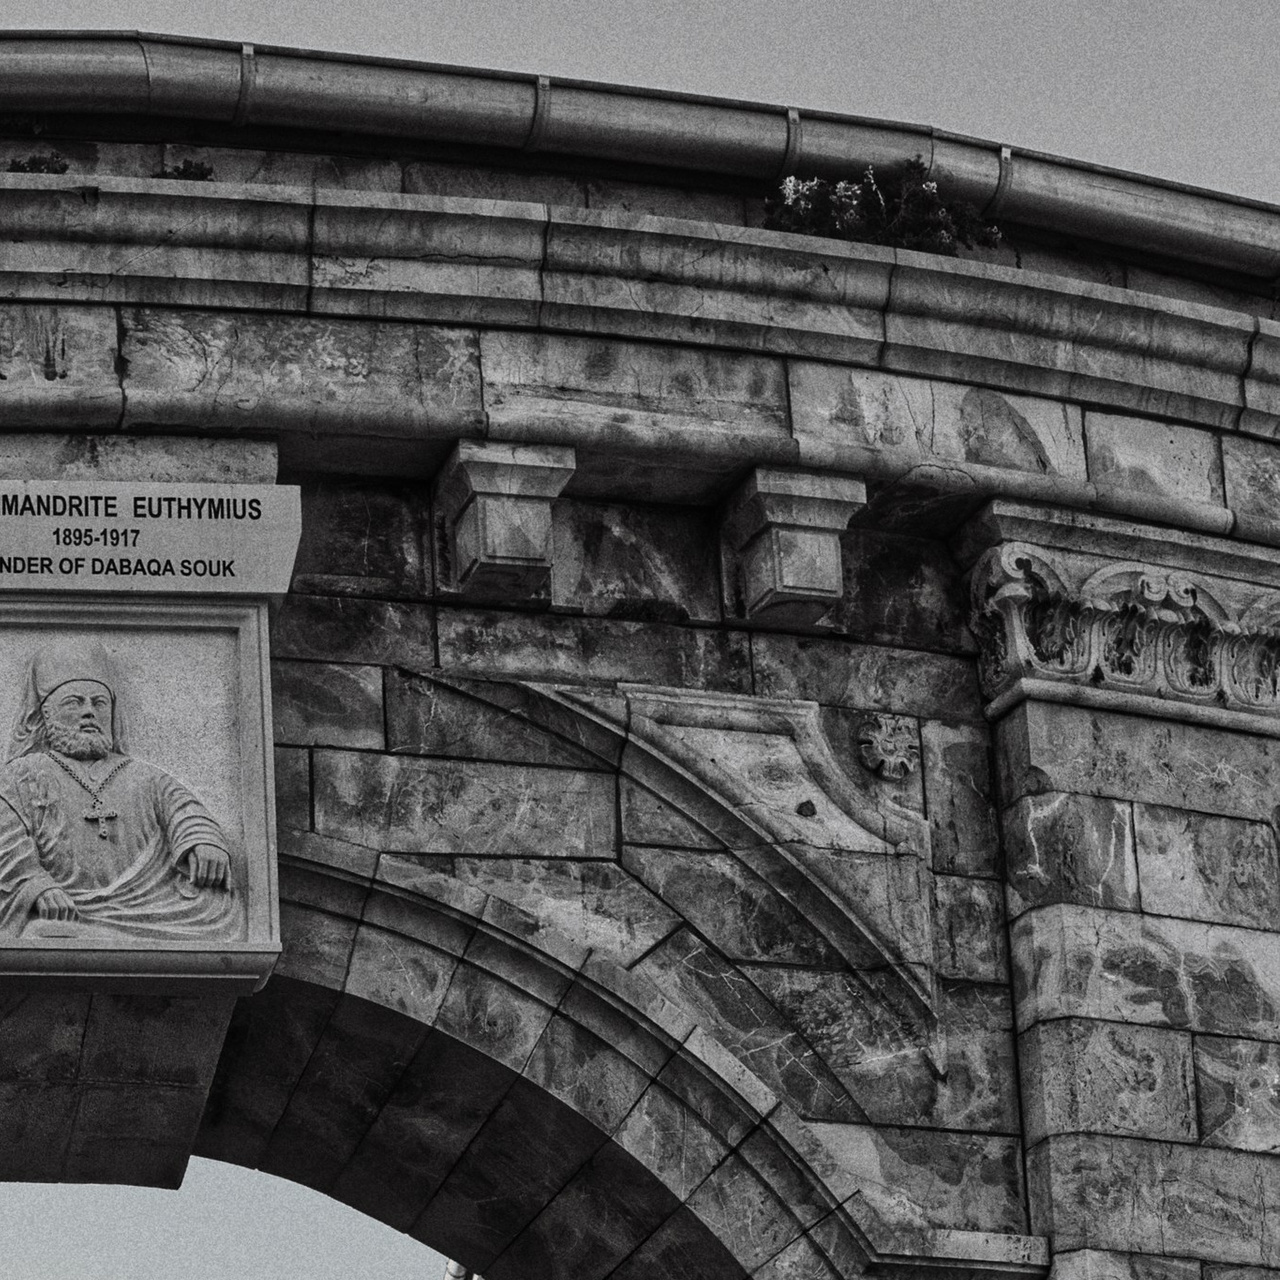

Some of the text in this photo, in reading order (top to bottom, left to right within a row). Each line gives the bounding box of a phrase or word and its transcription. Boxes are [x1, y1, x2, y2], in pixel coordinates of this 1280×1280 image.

[133, 496, 262, 520] EUTHYMIUS
[52, 527, 140, 548] 1895-1917
[58, 557, 85, 575] OF
[91, 557, 175, 576] DABAQA
[179, 559, 235, 577] SOUK
